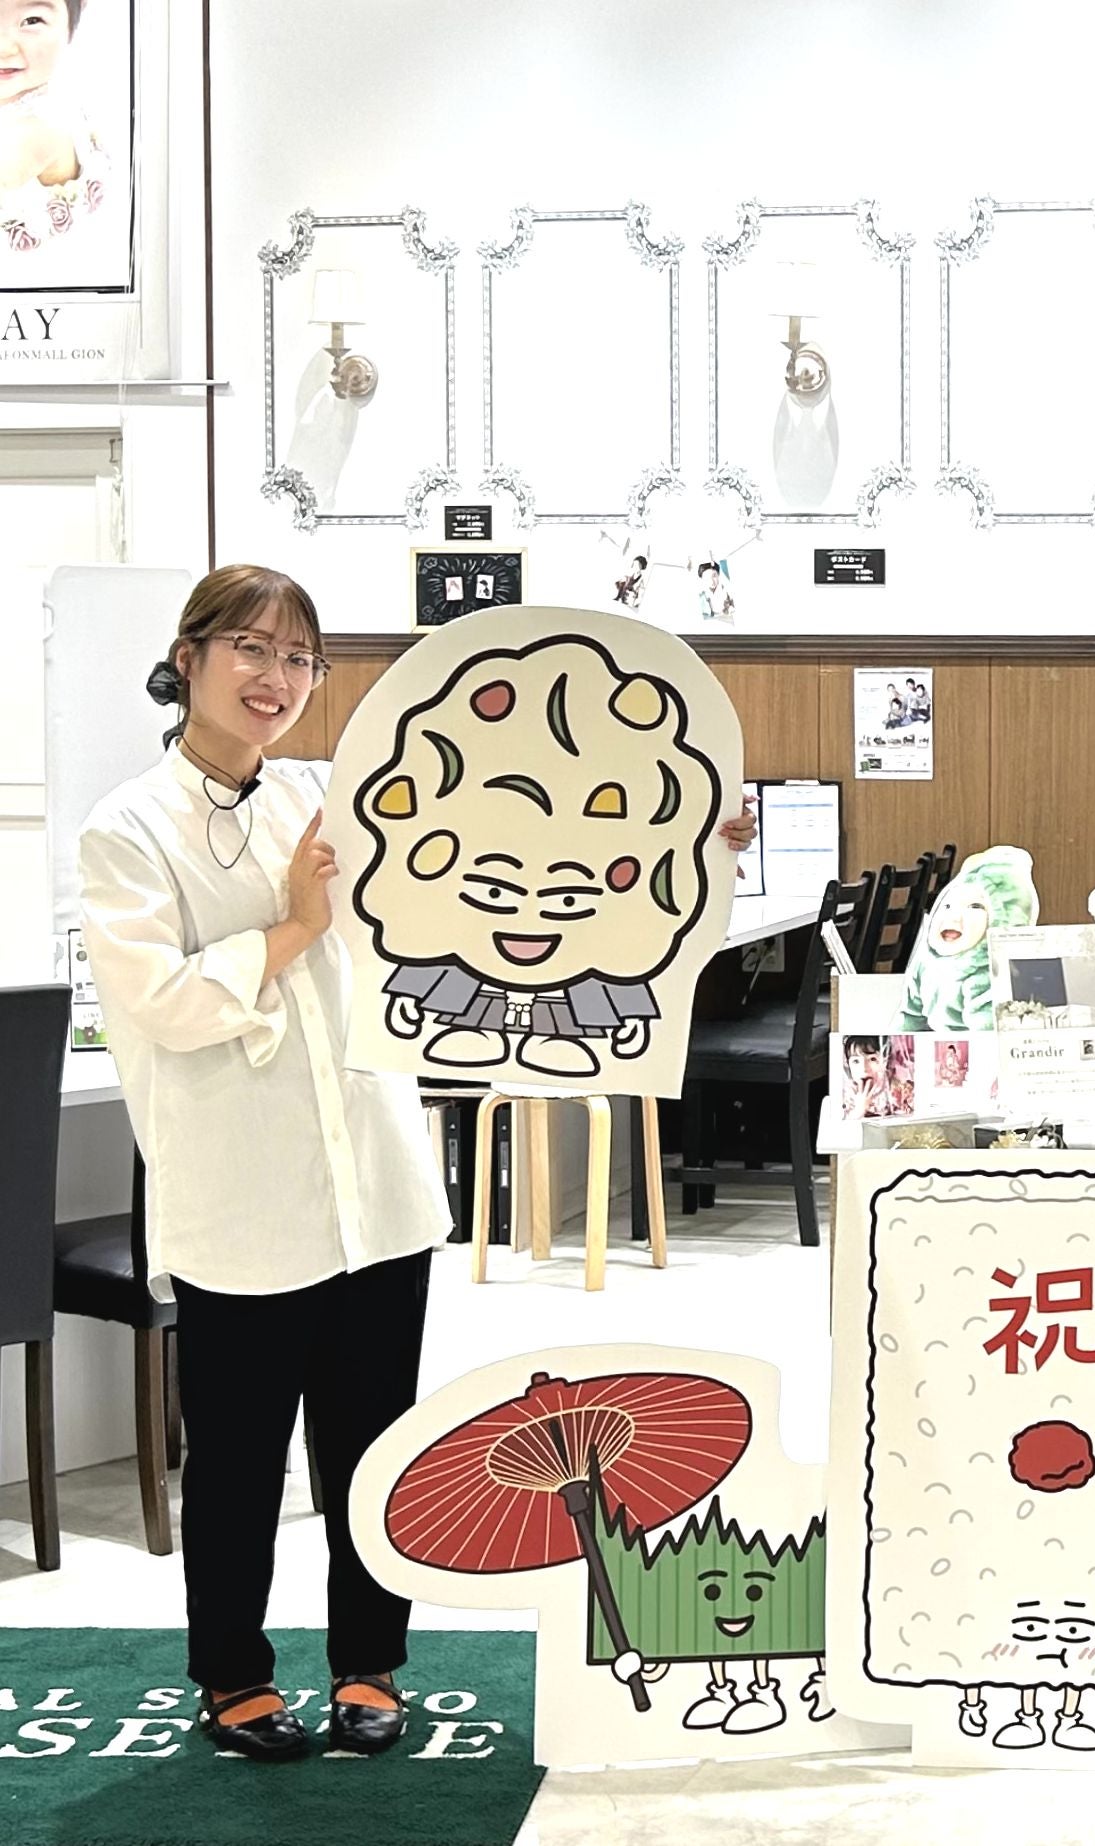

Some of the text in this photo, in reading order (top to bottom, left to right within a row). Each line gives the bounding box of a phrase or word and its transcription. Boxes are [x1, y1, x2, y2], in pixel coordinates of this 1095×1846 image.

[1, 308, 61, 340] AY
[71, 349, 105, 360] GION
[1010, 1046, 1065, 1059] Grandir
[0, 1717, 504, 1759] SEE
